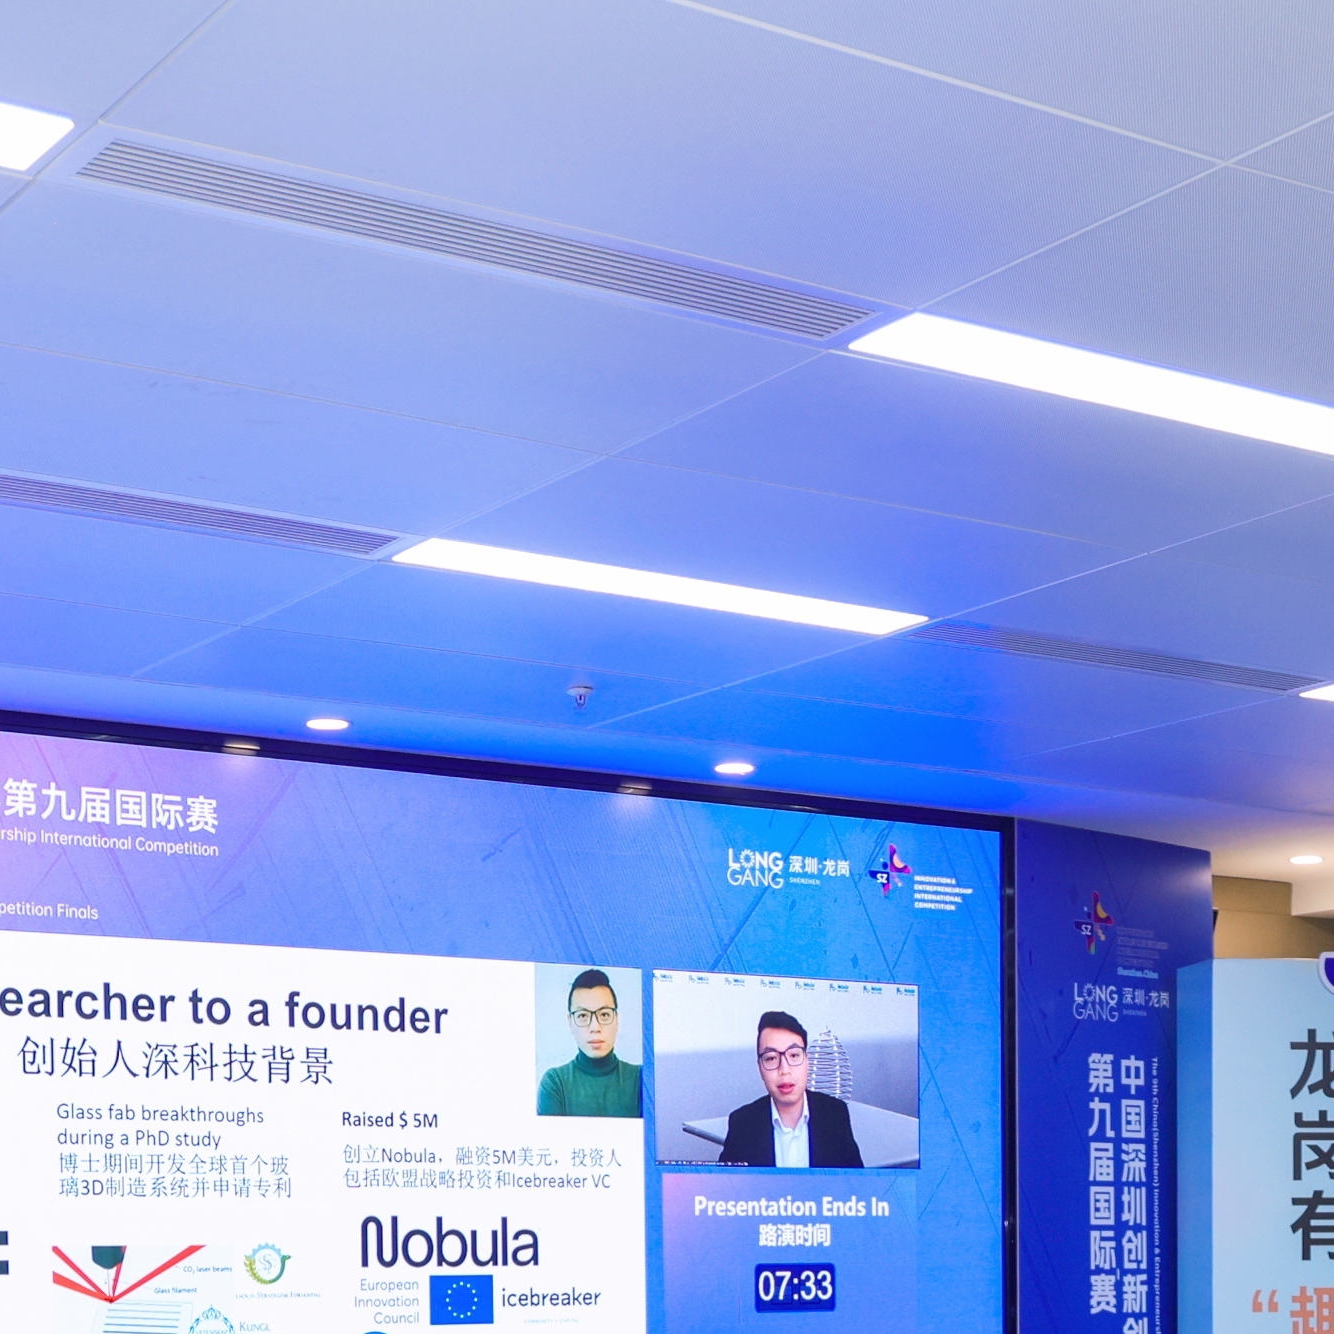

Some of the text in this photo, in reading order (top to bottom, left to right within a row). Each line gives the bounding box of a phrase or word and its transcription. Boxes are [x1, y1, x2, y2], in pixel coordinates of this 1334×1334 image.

[40, 829, 132, 851] International
[135, 836, 219, 858] Competition
[727, 847, 785, 872] LONG
[726, 867, 785, 890] GANG
[876, 872, 889, 884] SZ
[56, 902, 99, 921] Finals
[1080, 924, 1092, 935] SZ
[1073, 982, 1118, 1003] LONG
[188, 987, 232, 1025] to
[247, 998, 270, 1027] a
[285, 990, 449, 1035] founder
[1072, 999, 1119, 1022] GANG
[17, 1034, 334, 1086] 创始人深科技背景
[56, 1102, 265, 1127] Glass fab breakthroughs
[341, 1111, 439, 1129] Raised 5M
[57, 1128, 222, 1151] during PhD study
[58, 1151, 290, 1176] 博士期间开发全球首个玻
[58, 1175, 292, 1199] 璃3D制造系统并申请专利
[1087, 1052, 1118, 1315] 第九届国际赛
[693, 1195, 890, 1217] Presentation Ends In
[360, 1215, 540, 1268] Nobula
[757, 1223, 831, 1248] 路演时间
[359, 1278, 420, 1293] European
[757, 1269, 833, 1302] 07:33
[353, 1295, 420, 1309] Innovation
[501, 1287, 602, 1308] icebreaker
[373, 1311, 420, 1325] Council
